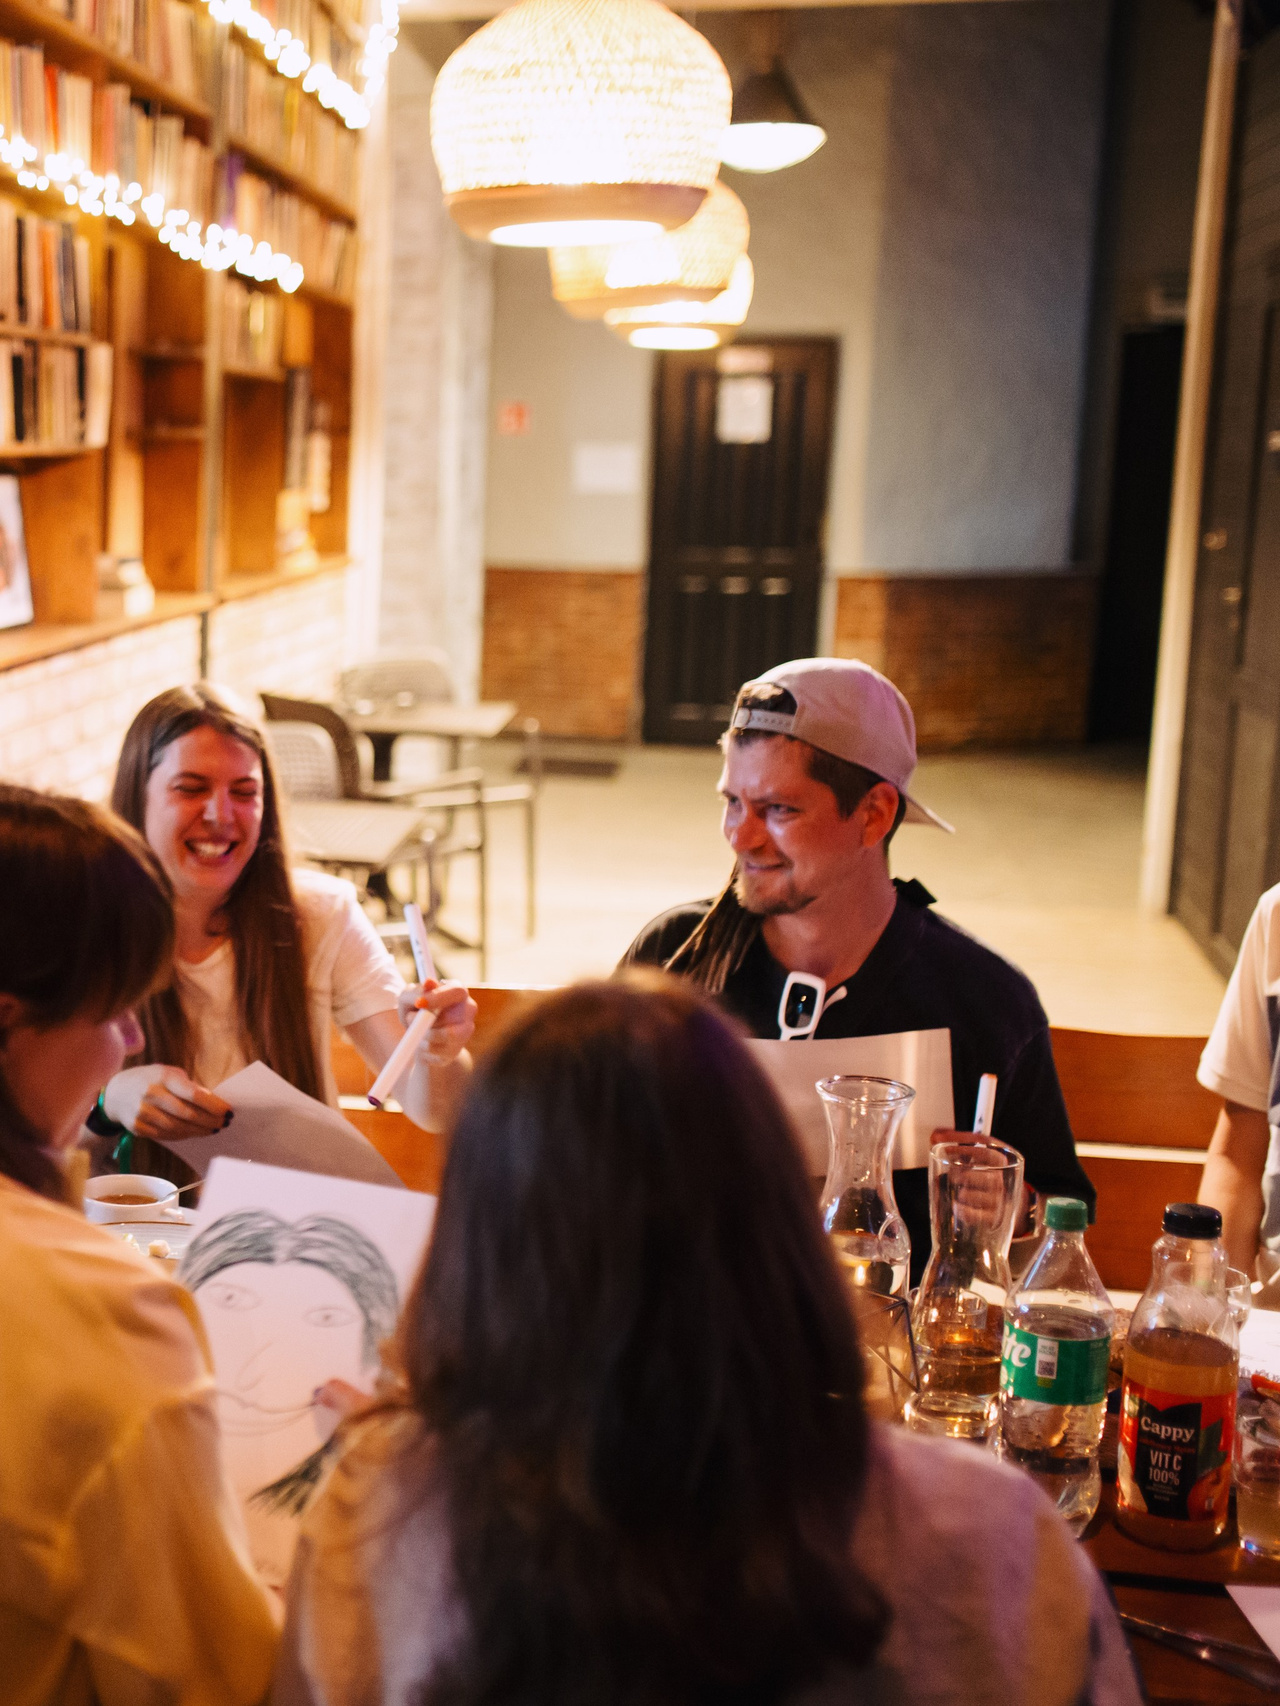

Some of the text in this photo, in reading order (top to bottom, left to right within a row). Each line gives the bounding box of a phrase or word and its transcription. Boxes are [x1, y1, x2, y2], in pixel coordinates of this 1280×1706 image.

[1140, 1416, 1195, 1443] Cappy
[1150, 1449, 1182, 1471] VIT C
[1149, 1467, 1180, 1486] 100%
